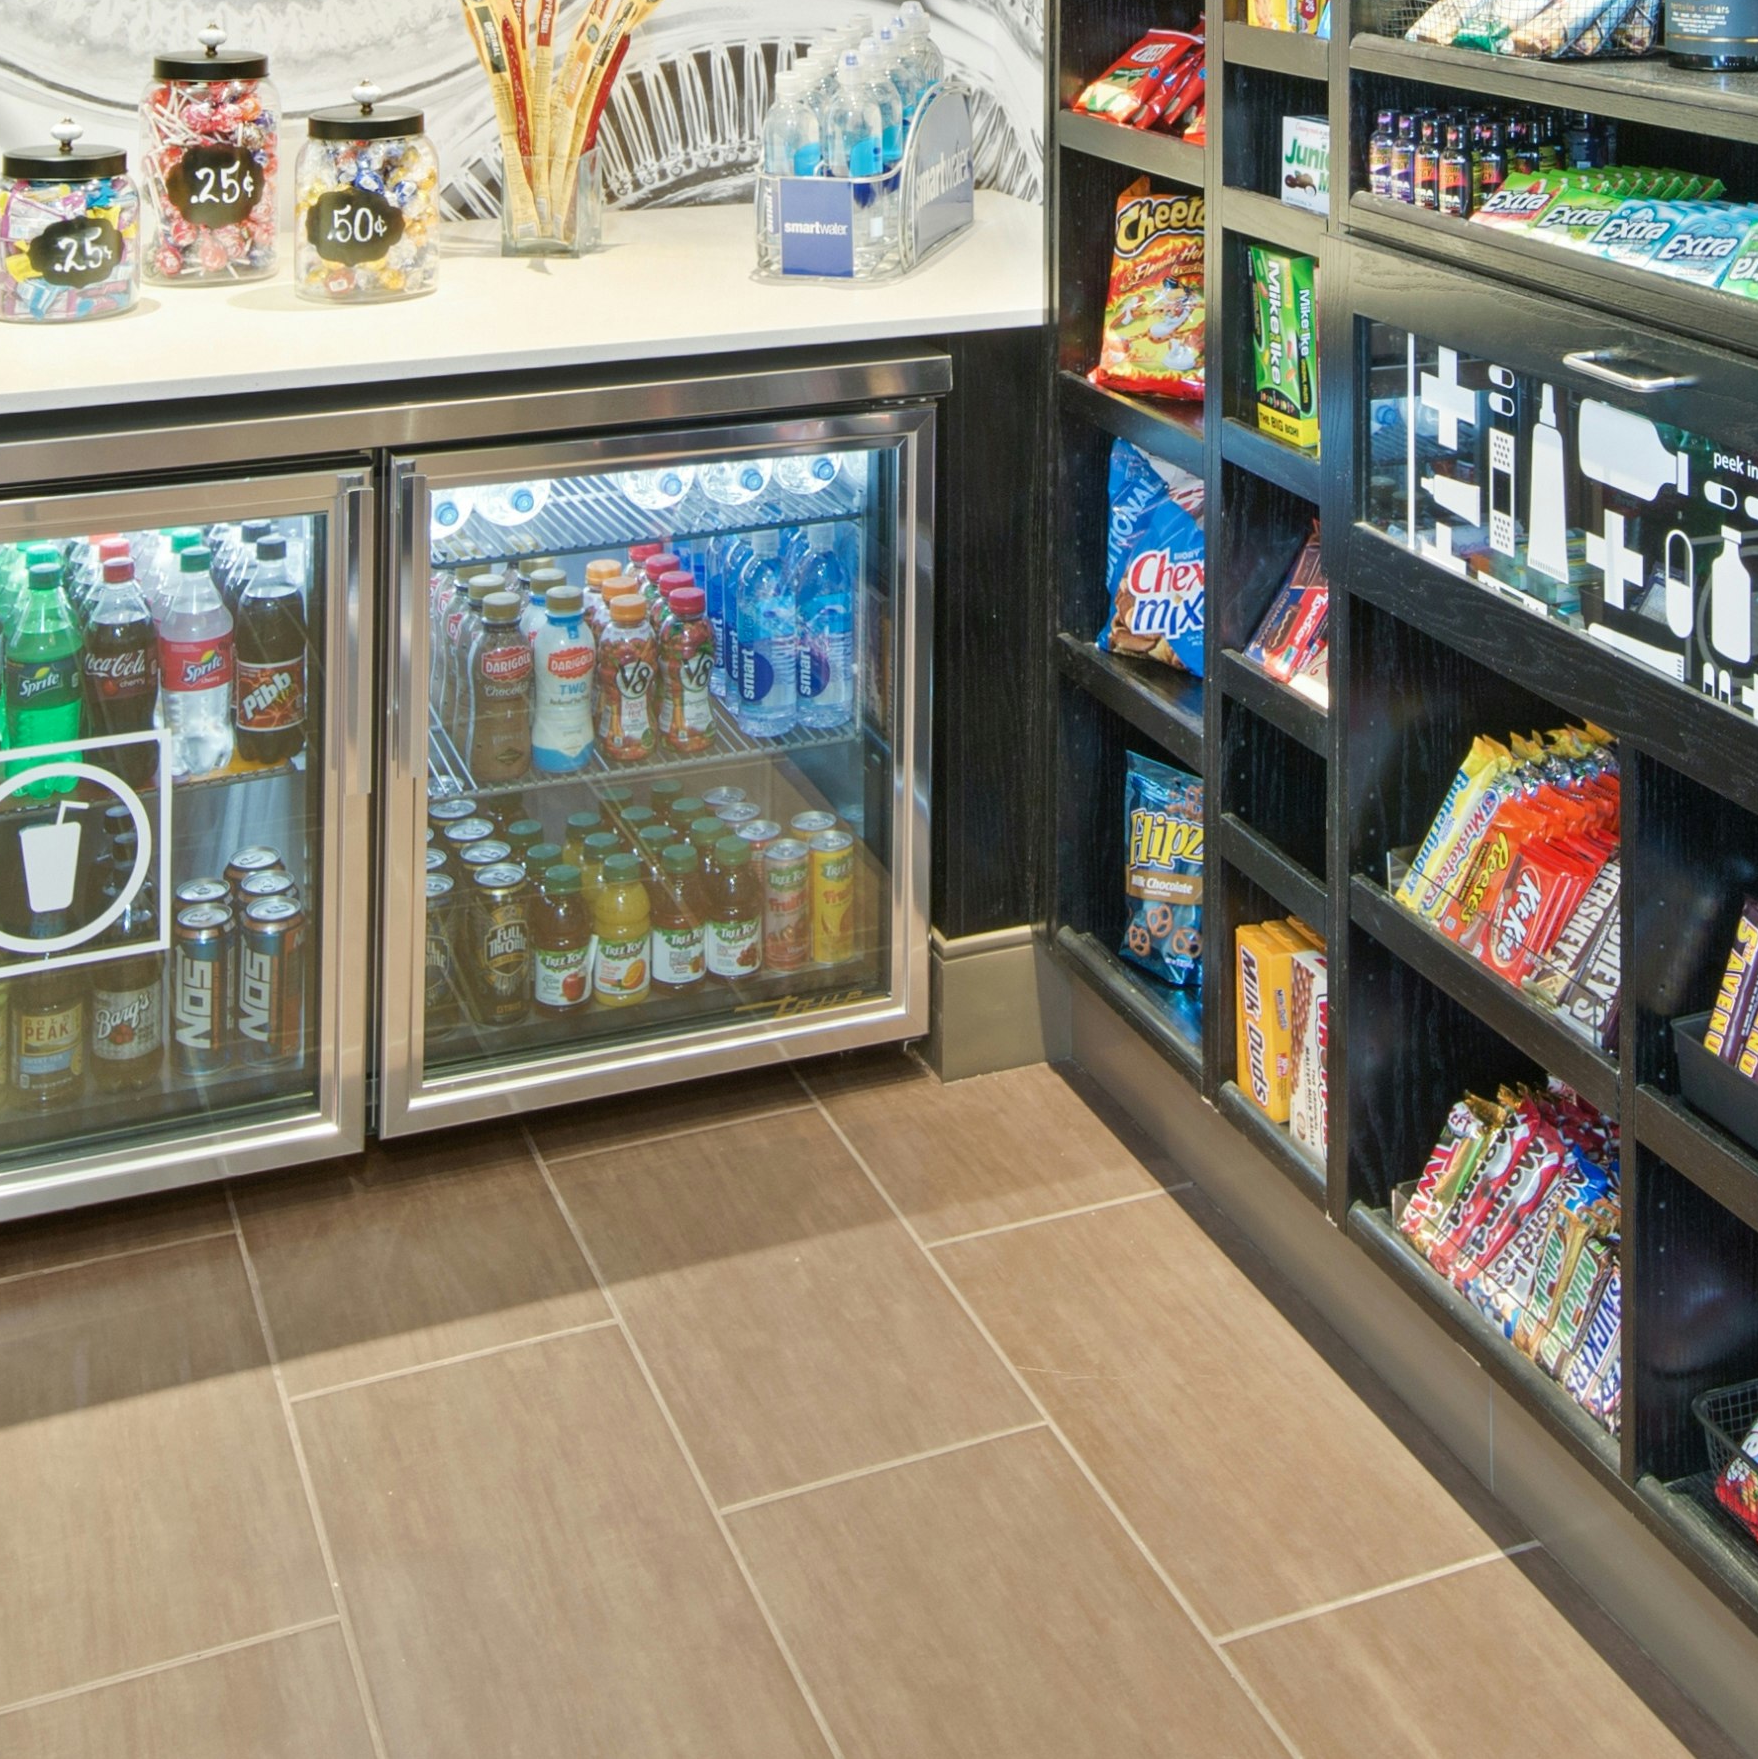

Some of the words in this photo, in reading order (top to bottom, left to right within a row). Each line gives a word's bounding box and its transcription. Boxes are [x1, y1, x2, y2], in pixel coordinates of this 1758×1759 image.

[1484, 191, 1549, 213] Extra
[1538, 205, 1611, 228] Extra
[784, 221, 848, 235] smartwater
[1592, 218, 1670, 243] Extra
[1656, 230, 1739, 268] Extra
[1713, 451, 1744, 476] peek
[1134, 591, 1204, 638] mix
[85, 649, 145, 678] Coca-Cola
[183, 654, 223, 682] Sprite
[486, 652, 531, 673] DARIGOLD
[551, 652, 594, 672] DARIGOLD
[619, 660, 651, 694] V8
[684, 652, 711, 688] V8
[742, 649, 754, 700] smart
[800, 645, 811, 696] smart
[19, 672, 59, 697] Sprite
[242, 670, 291, 721] Pibb
[1130, 810, 1203, 866] Flipz
[1408, 769, 1469, 895] Butterfinger
[1147, 877, 1193, 894] Chocolate
[1459, 832, 1509, 926] Reese's
[176, 944, 212, 1049] NOS
[240, 948, 270, 1042] NOS
[1241, 946, 1261, 1020] Milk
[24, 1021, 70, 1041] PEAK
[95, 989, 151, 1038] Barq's
[1248, 1023, 1268, 1107] Duds
